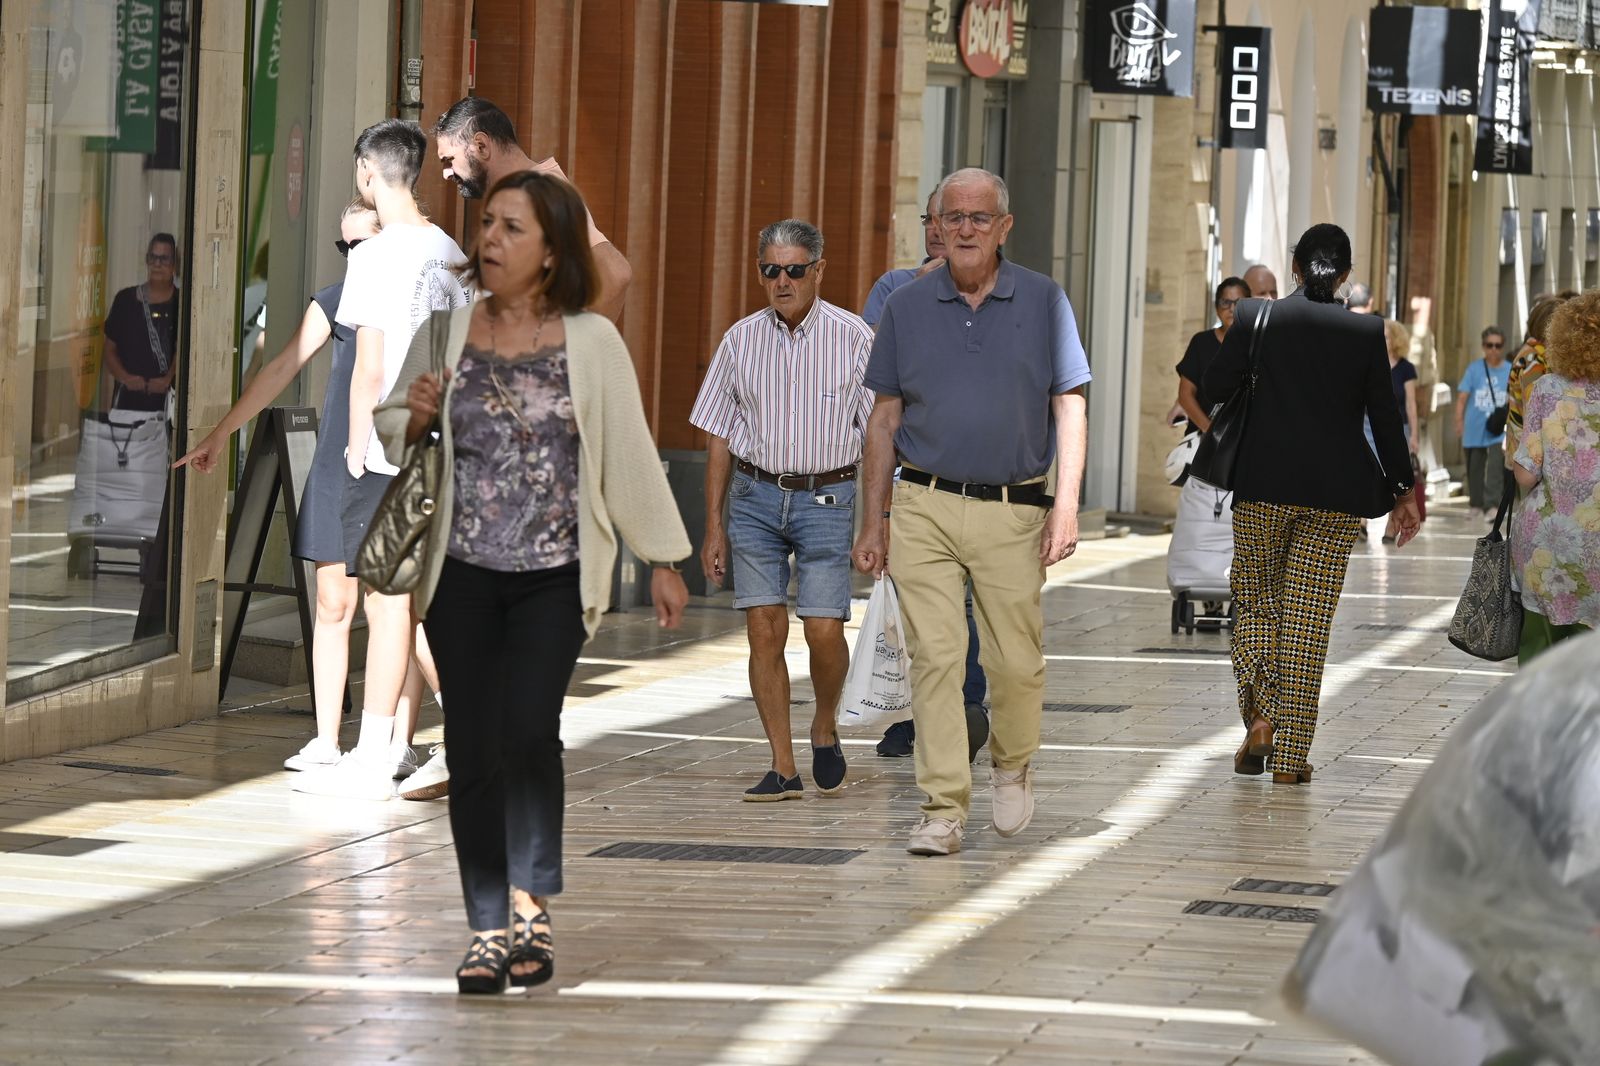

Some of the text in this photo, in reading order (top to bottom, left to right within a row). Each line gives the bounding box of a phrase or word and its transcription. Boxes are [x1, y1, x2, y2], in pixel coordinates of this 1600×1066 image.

[967, 0, 1010, 65] BRUTAL
[1109, 33, 1182, 69] BRUTAL
[1498, 27, 1516, 79] ESTATE
[1494, 82, 1512, 120] REAL
